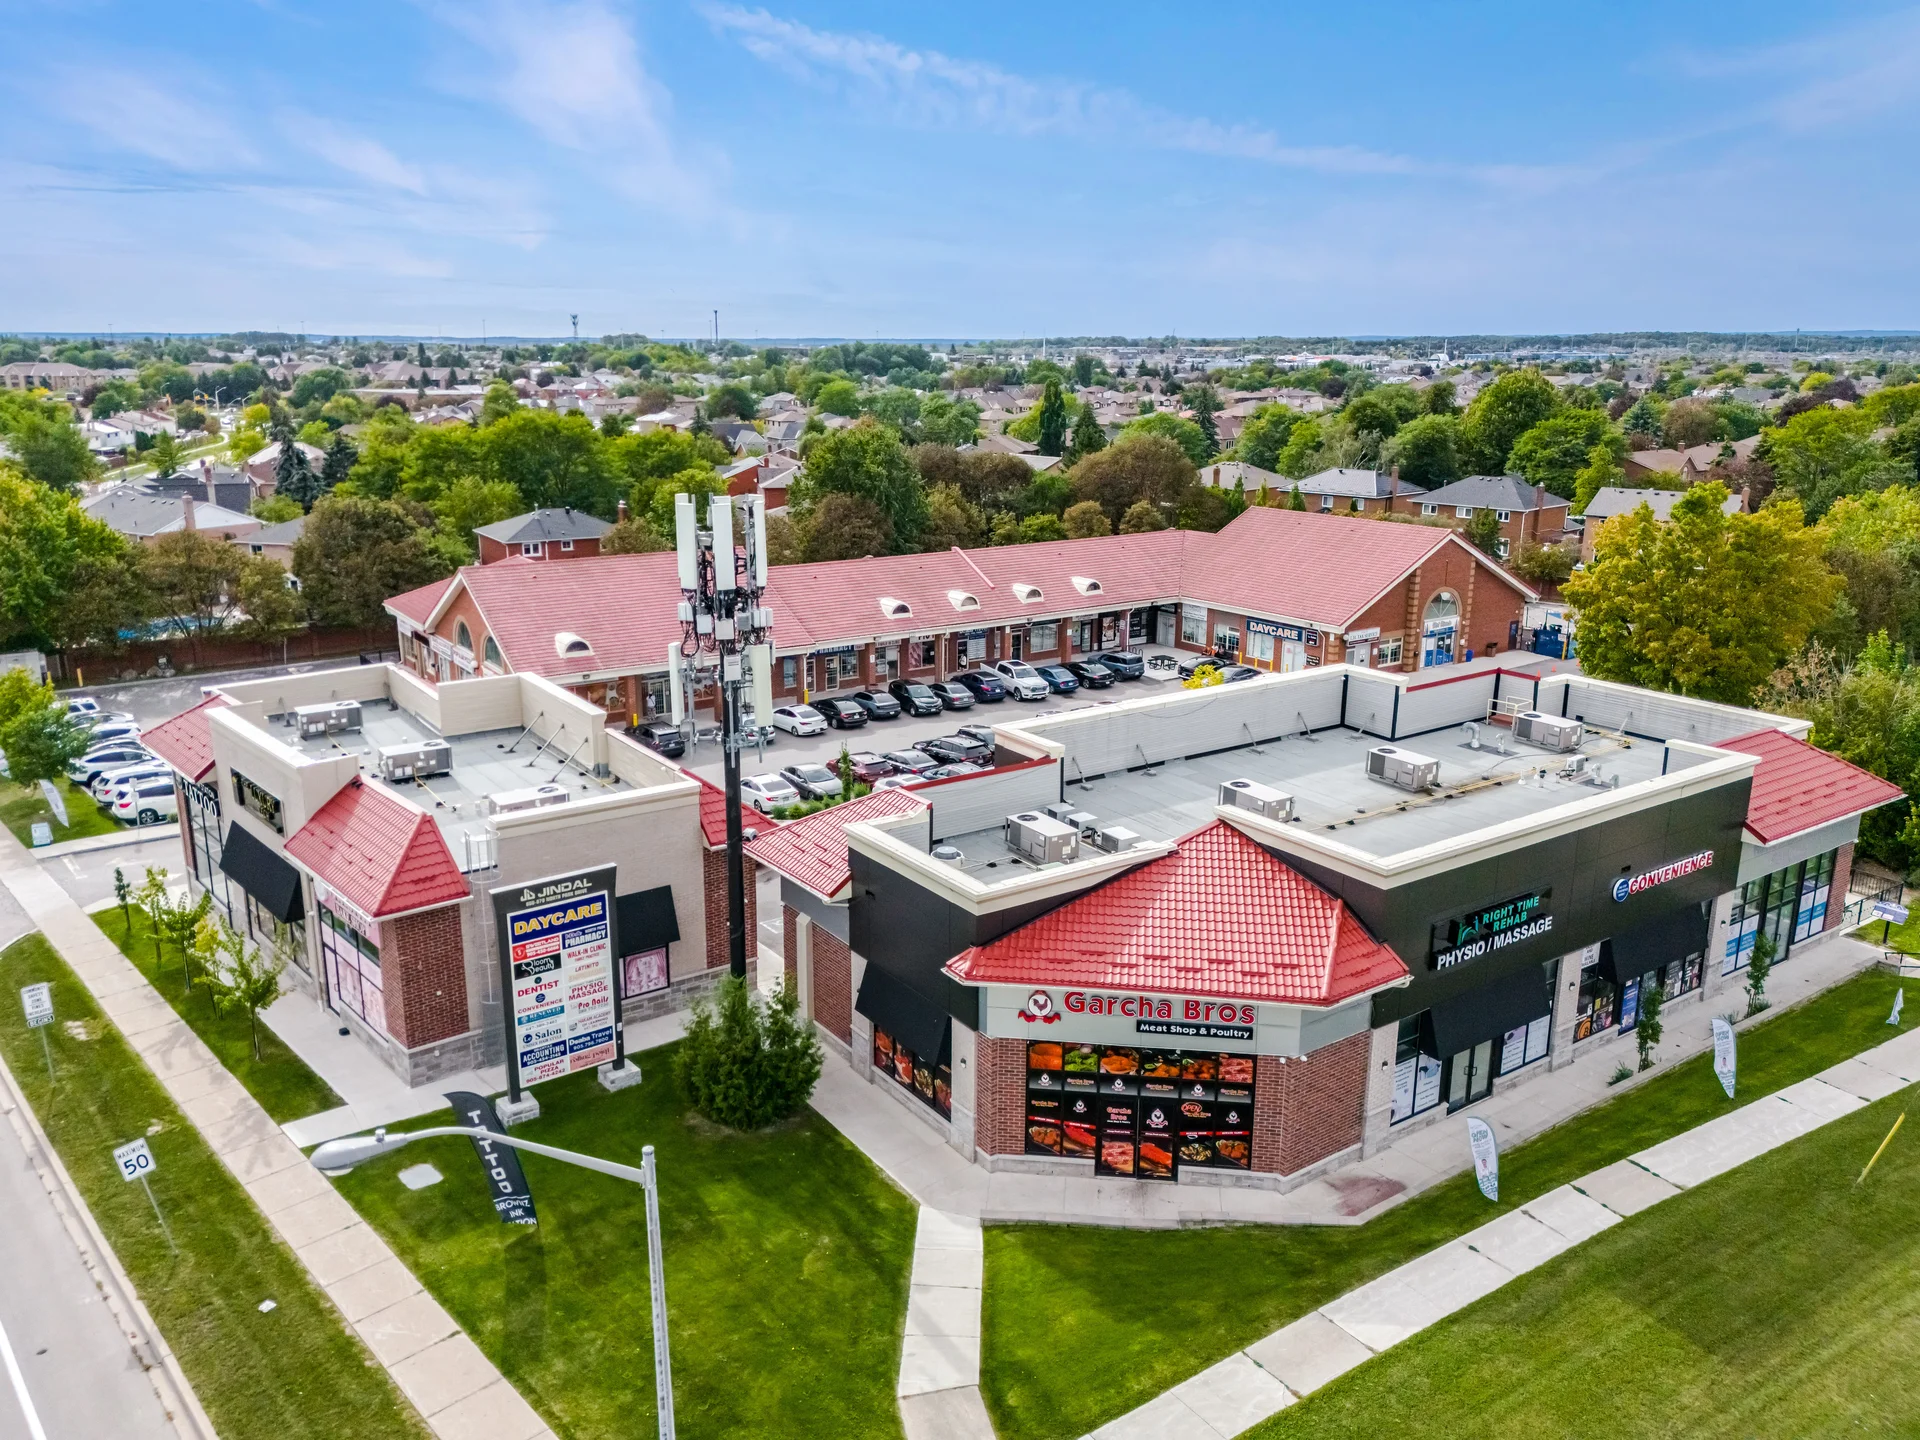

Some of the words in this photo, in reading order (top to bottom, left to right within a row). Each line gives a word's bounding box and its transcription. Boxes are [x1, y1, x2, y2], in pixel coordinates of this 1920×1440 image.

[1250, 621, 1299, 640] DAYCARE
[815, 644, 852, 655] PHARMACY
[183, 778, 217, 818] TATTOO
[1629, 850, 1715, 895] CONVENIENCE
[537, 878, 593, 898] JINDAL
[562, 891, 574, 899] PARK
[1482, 904, 1515, 925] RIGHT
[1516, 895, 1540, 912] TIME
[514, 901, 603, 936] DAYCARE
[1492, 911, 1528, 932] REHAB
[565, 929, 606, 948] PHARMACY
[1436, 940, 1486, 971] PHYSIO
[1493, 915, 1553, 950] MASSAGE
[567, 948, 589, 959] WALK-IN
[590, 942, 607, 953] CLINIC
[28, 991, 43, 999] SAFETY
[517, 979, 560, 998] DENTIST
[568, 985, 609, 1001] MASSAGE
[517, 998, 563, 1014] CONVENIENCE
[578, 1002, 590, 1010] Pro
[591, 995, 609, 1006] Nails
[1063, 991, 1173, 1020] Garcha
[1183, 999, 1256, 1025] Bros
[529, 1006, 561, 1018] RENEWED
[535, 1028, 562, 1040] Salon
[591, 1028, 612, 1039] Travel
[1140, 1023, 1168, 1032] Meat
[1170, 1025, 1197, 1035] Shop
[1199, 1027, 1208, 1035] &
[1210, 1028, 1250, 1039] Poultry
[522, 1044, 565, 1063] ACCOUNTING
[534, 1058, 564, 1071] POPULAR
[540, 1065, 559, 1075] PIZZA
[1106, 1106, 1132, 1115] Garcha
[1182, 1103, 1202, 1113] OPEN
[1110, 1113, 1128, 1121] Bros
[1471, 1129, 1489, 1139] OPEN
[117, 1143, 145, 1159] MAXIMUM
[123, 1153, 149, 1176] 50
[509, 1208, 525, 1218] INK
